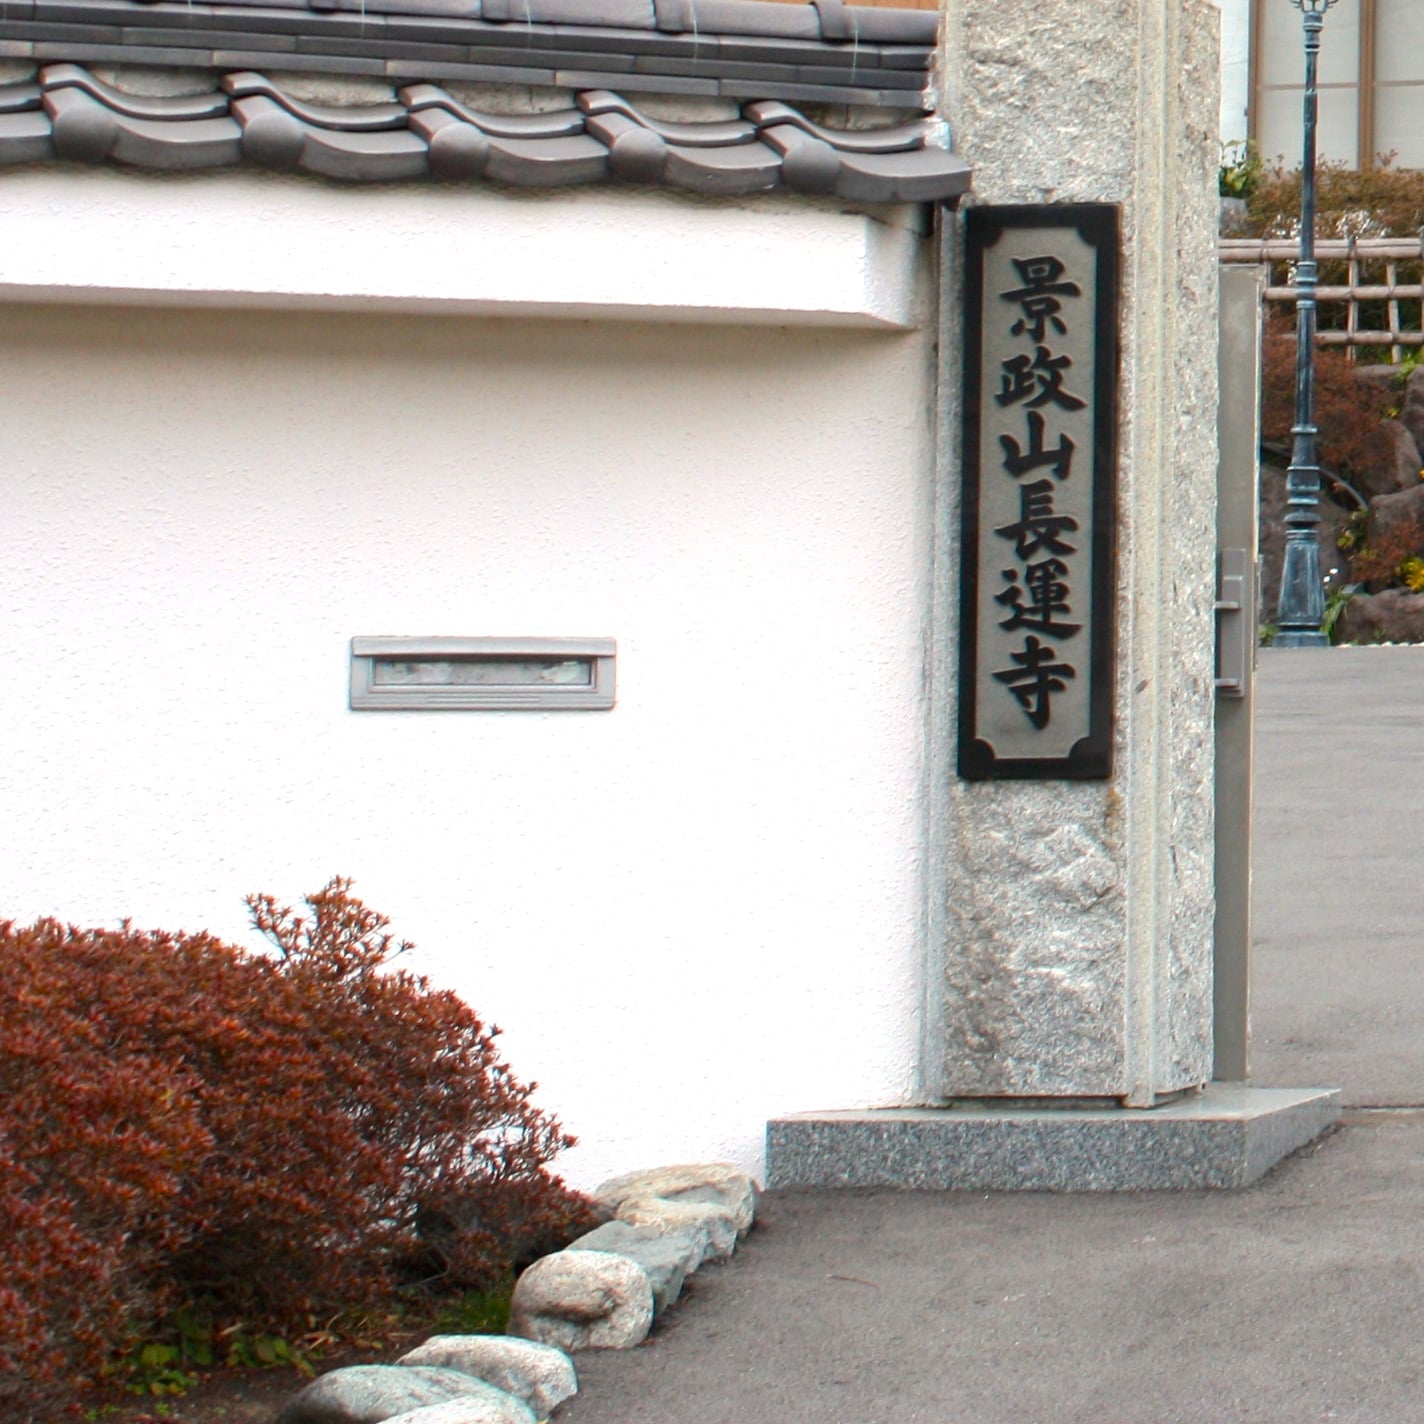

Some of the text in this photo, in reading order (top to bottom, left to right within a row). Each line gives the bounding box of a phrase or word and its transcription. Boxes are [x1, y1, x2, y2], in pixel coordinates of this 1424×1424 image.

[991, 255, 1088, 731] 景政山長運寺
